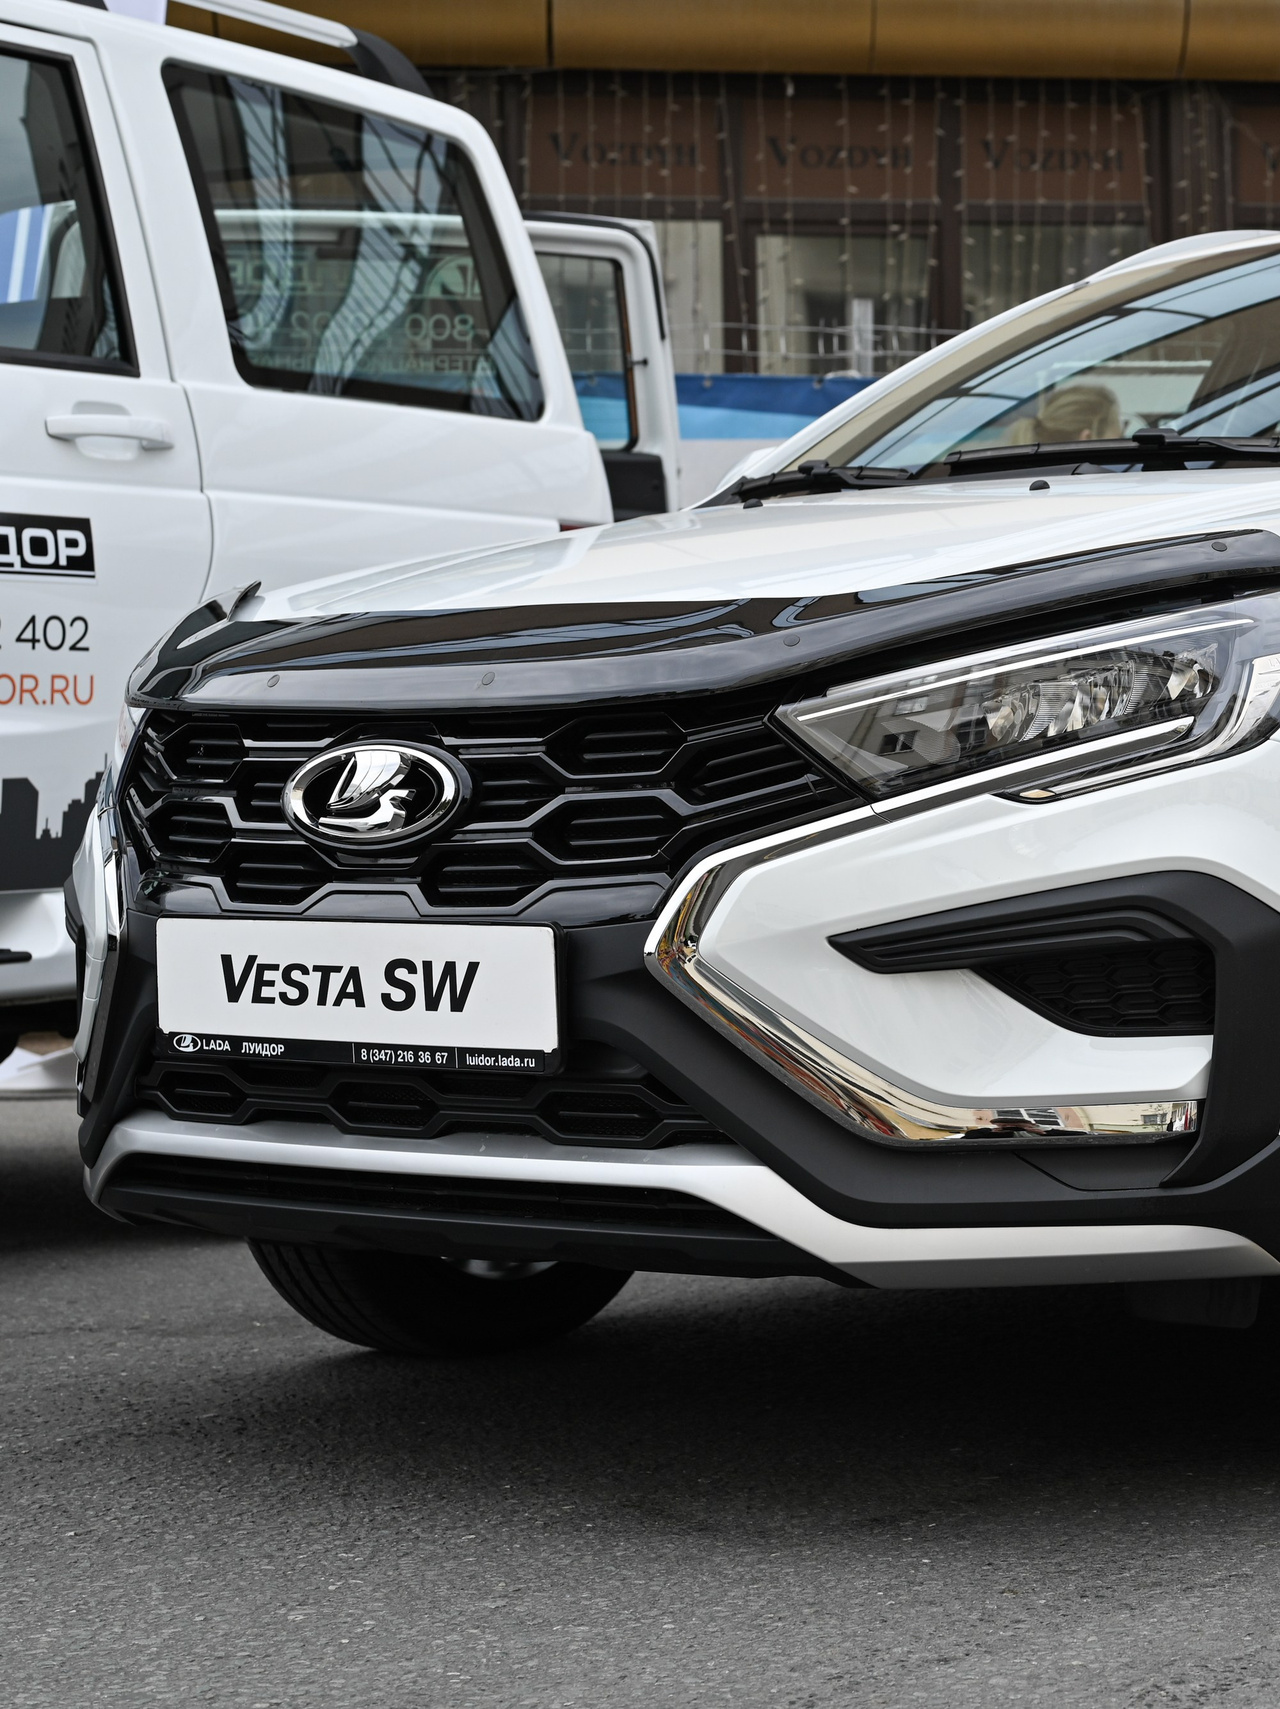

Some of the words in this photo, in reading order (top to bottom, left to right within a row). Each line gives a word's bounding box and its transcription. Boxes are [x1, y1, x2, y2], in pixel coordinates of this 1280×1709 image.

[15, 614, 90, 652] 402
[220, 953, 366, 1009] VESTA
[380, 957, 480, 1013] SW
[203, 1039, 231, 1051] LADA
[241, 1042, 285, 1056] ЛУИДОР
[361, 1049, 367, 1061] 8
[369, 1049, 395, 1064] (347)
[397, 1050, 414, 1063] 216
[418, 1052, 431, 1063] 36
[435, 1052, 448, 1064] 67
[466, 1053, 536, 1068] luidor.lada.ru
